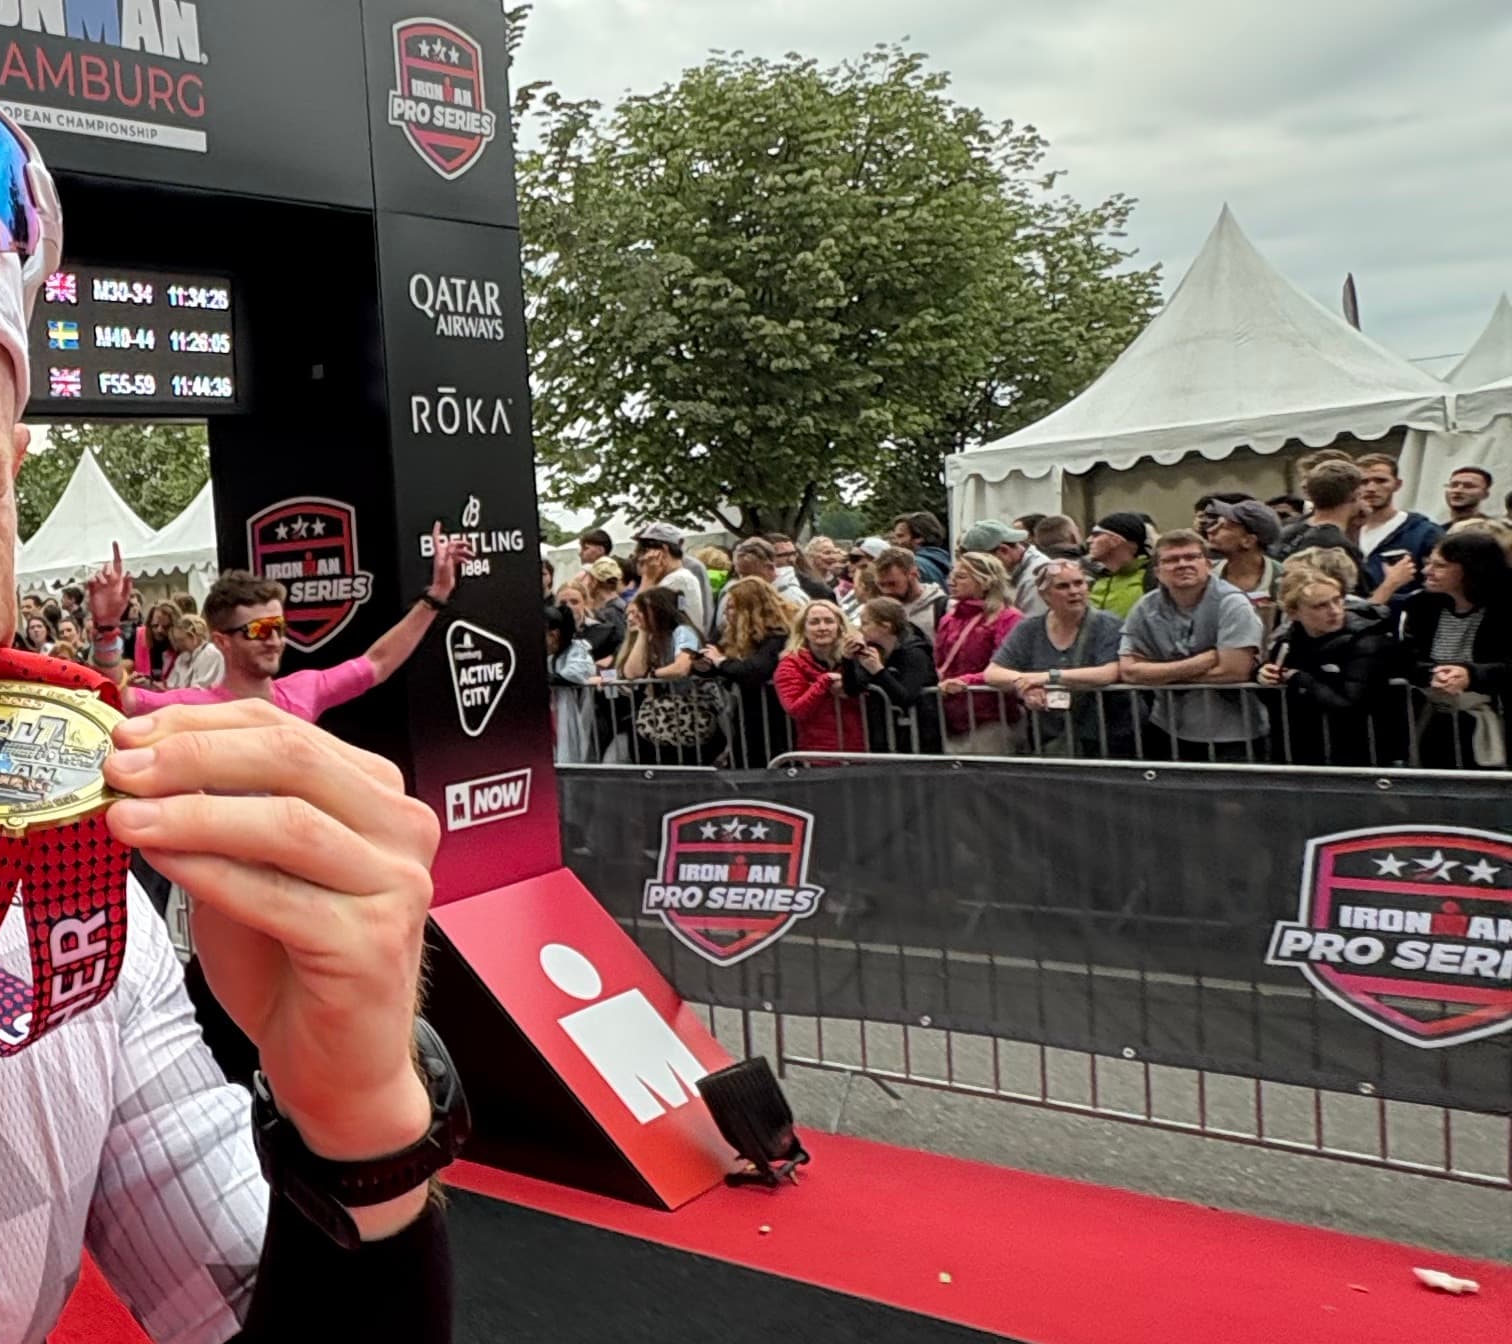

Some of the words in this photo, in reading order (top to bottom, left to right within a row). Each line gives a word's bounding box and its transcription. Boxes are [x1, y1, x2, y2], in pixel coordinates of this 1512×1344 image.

[411, 75, 473, 107] IRONMAN
[4, 106, 52, 124] OPEAN
[56, 114, 158, 139] CHAMPIONSHIP
[393, 97, 431, 123] PRO
[433, 105, 492, 135] SERIES
[409, 273, 502, 319] QATAR
[436, 315, 504, 340] AIRWAYS
[420, 530, 523, 557] BTLING
[265, 551, 340, 579] IRONMAN
[461, 558, 490, 576] 1884
[289, 577, 367, 603] SERIES
[459, 662, 504, 687] ACTIVE
[462, 685, 490, 707] CITY
[473, 780, 523, 816] NOW
[678, 855, 781, 884] IRONMAN
[647, 885, 703, 908] PRO
[705, 887, 815, 912] SERIES
[1278, 929, 1385, 965] PRO
[1390, 940, 1512, 979] SERI
